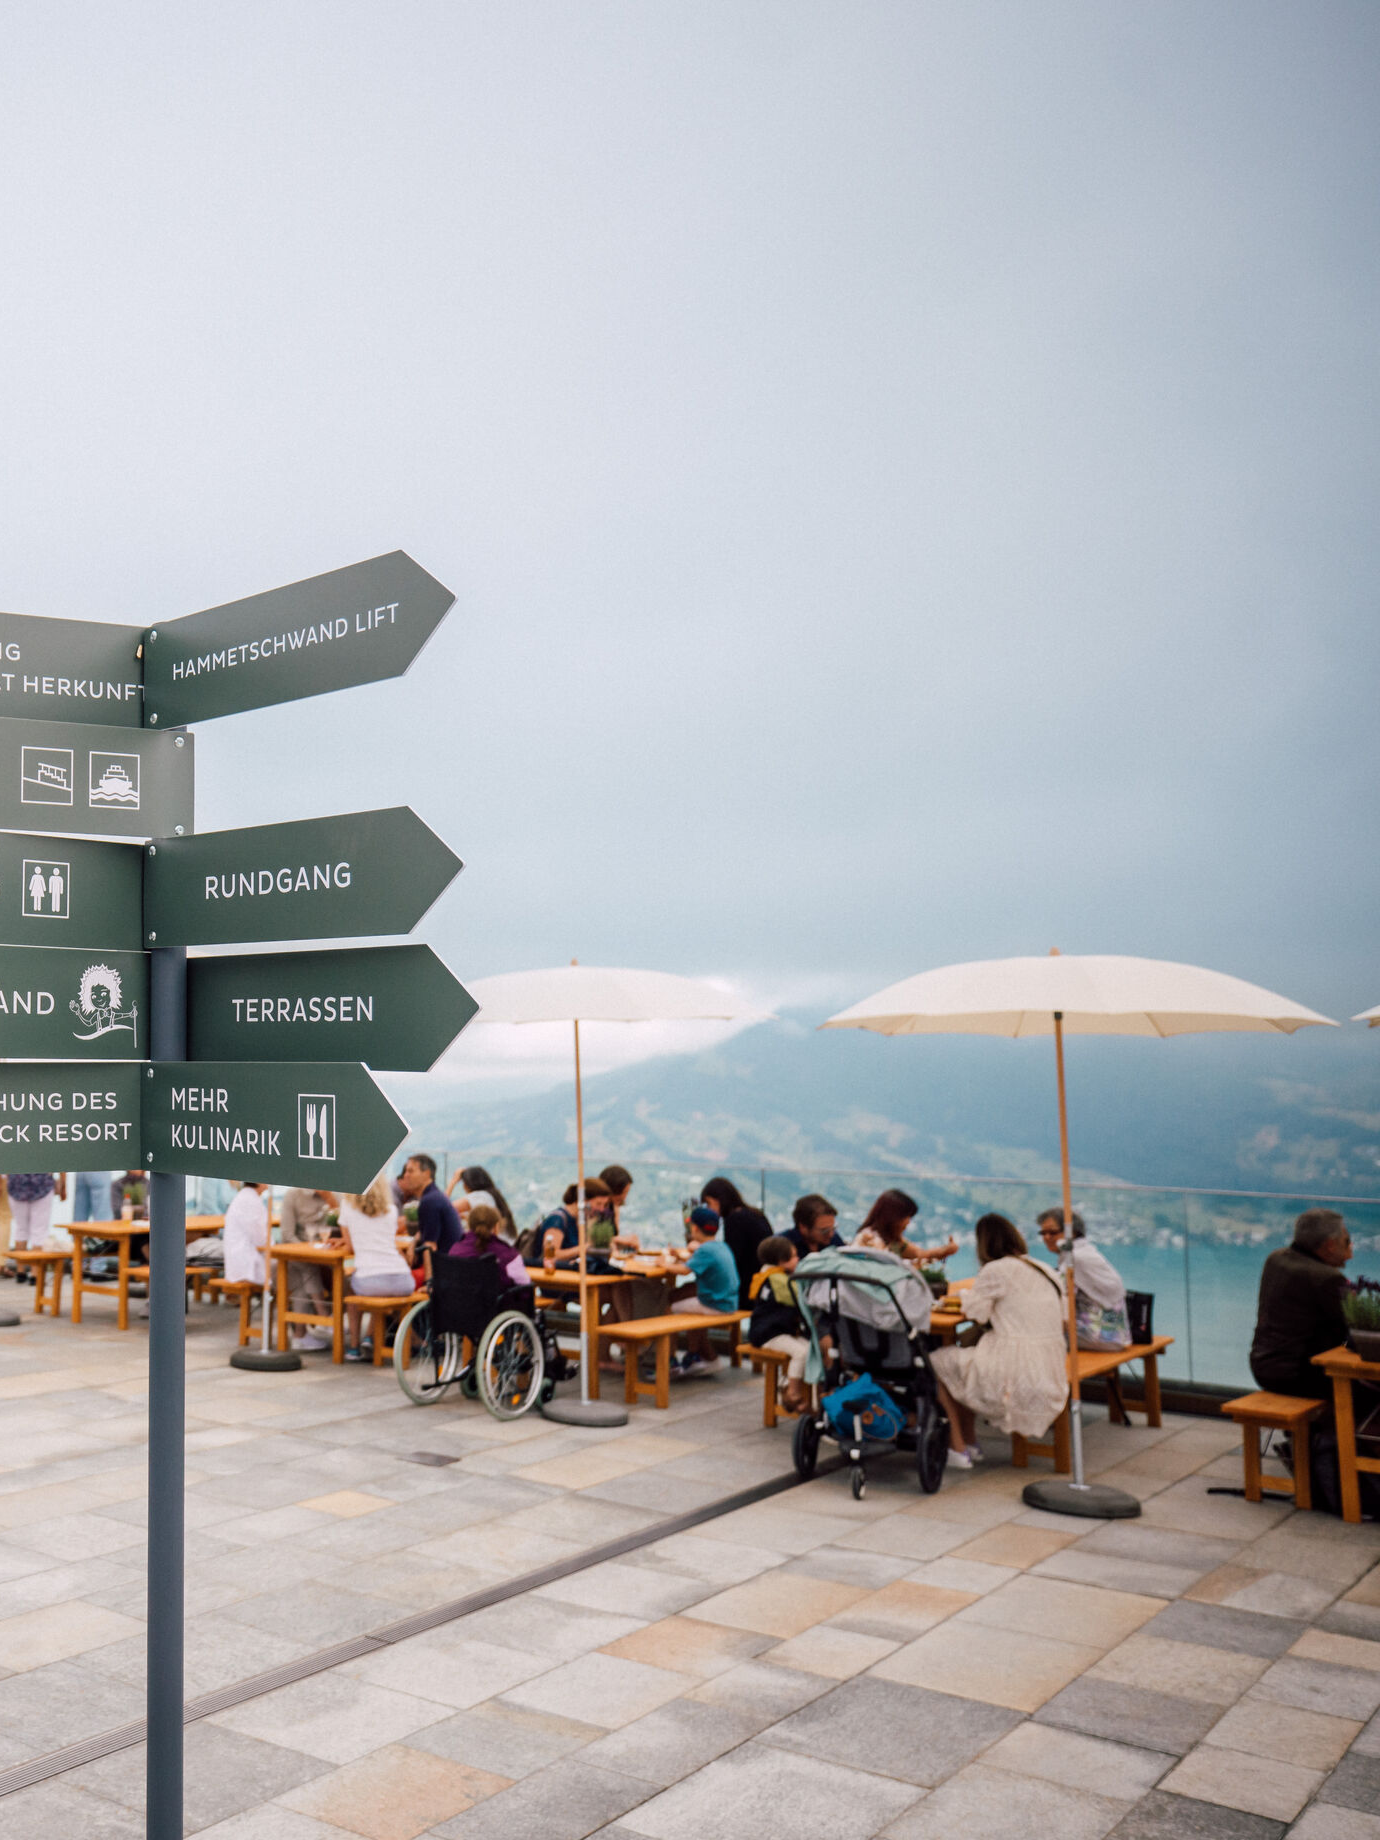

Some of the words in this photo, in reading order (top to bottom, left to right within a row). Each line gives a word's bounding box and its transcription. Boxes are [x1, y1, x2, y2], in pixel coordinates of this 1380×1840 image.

[172, 618, 349, 681] HAMMETSCHWAND
[356, 602, 400, 633] LIFT
[205, 862, 352, 900] RUNDGANG
[231, 995, 374, 1023] TERRASSEN
[72, 1091, 118, 1111] DES
[171, 1087, 229, 1113] MEHR
[39, 1122, 133, 1143] RESORT
[171, 1124, 282, 1156] KULINARIK
